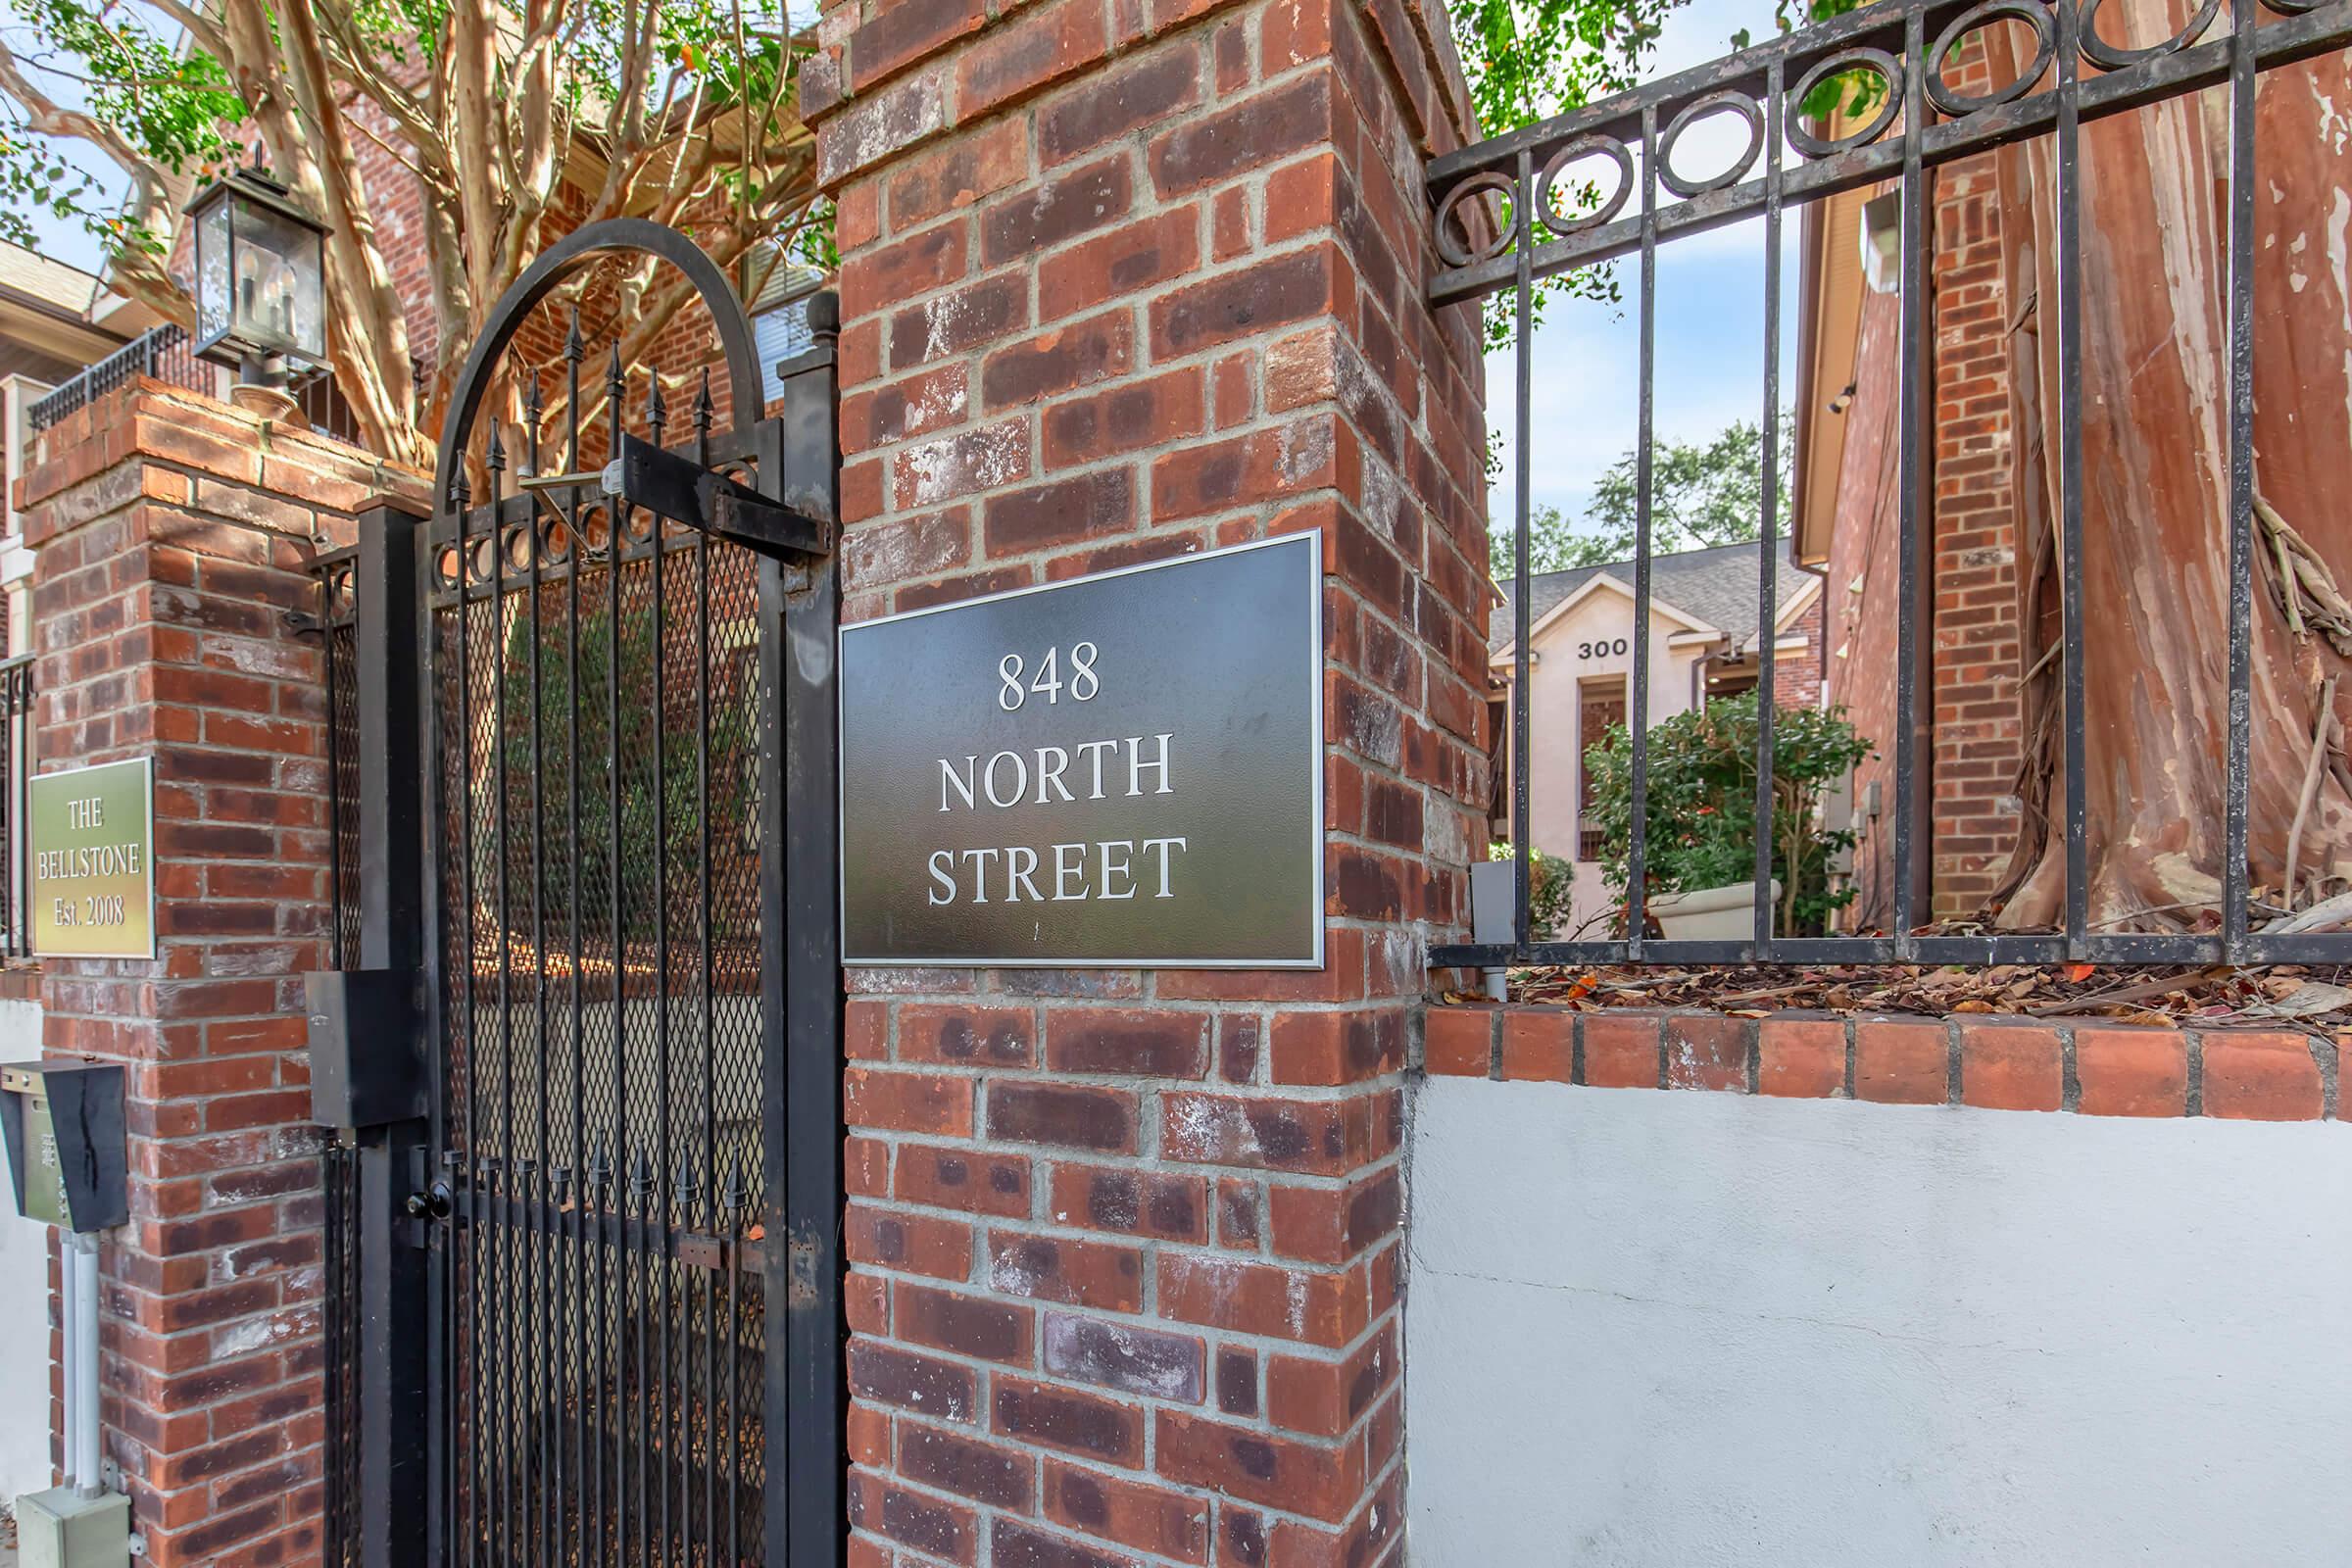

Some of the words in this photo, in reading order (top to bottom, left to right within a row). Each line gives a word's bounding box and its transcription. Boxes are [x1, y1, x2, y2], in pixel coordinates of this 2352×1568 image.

[1578, 638, 1628, 660] 300
[998, 641, 1101, 711] 848
[937, 733, 1175, 812] NORTH
[68, 797, 103, 830] THE
[38, 843, 140, 880] BELLSTONE
[928, 837, 1187, 906] STREET
[55, 897, 82, 926] Est.
[86, 895, 124, 926] 2008
